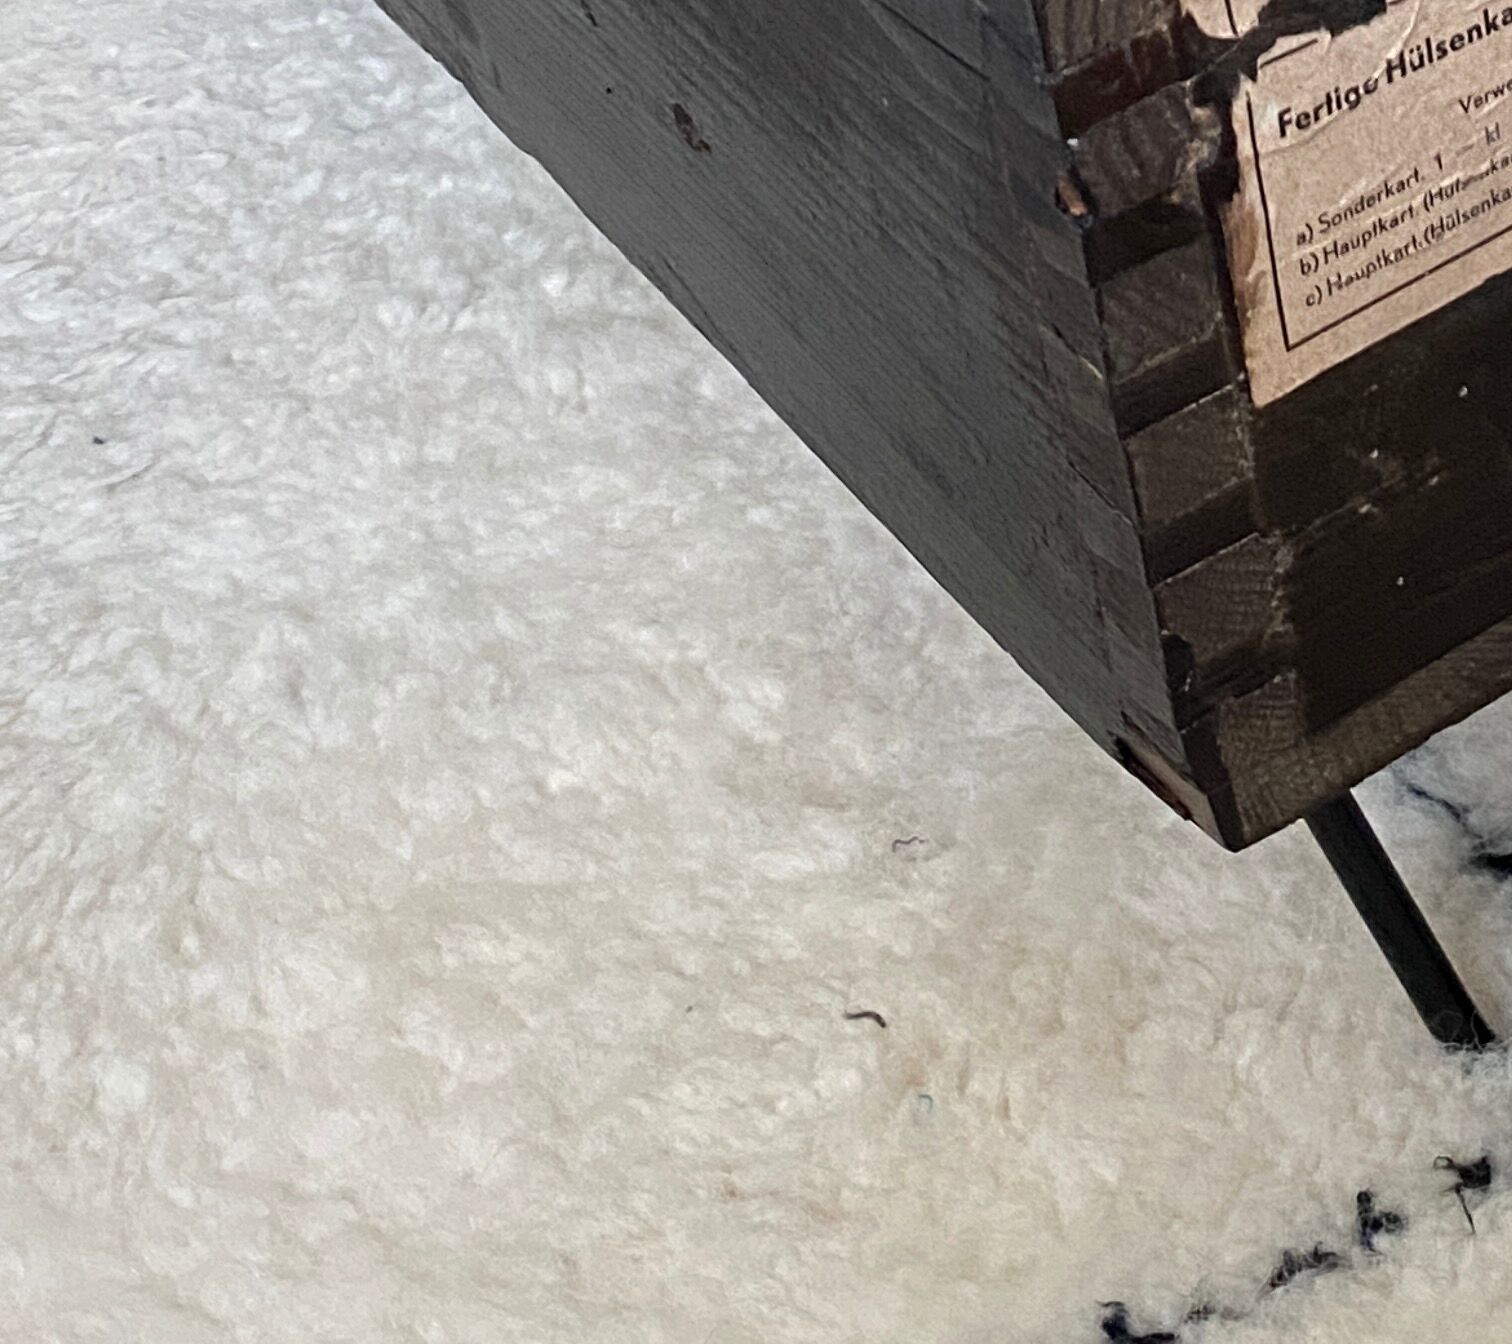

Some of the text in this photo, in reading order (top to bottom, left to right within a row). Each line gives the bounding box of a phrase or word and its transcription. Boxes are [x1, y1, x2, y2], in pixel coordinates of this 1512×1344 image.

[1295, 223, 1313, 247] a)
[1299, 252, 1320, 276] b)
[1305, 284, 1323, 308] c)
